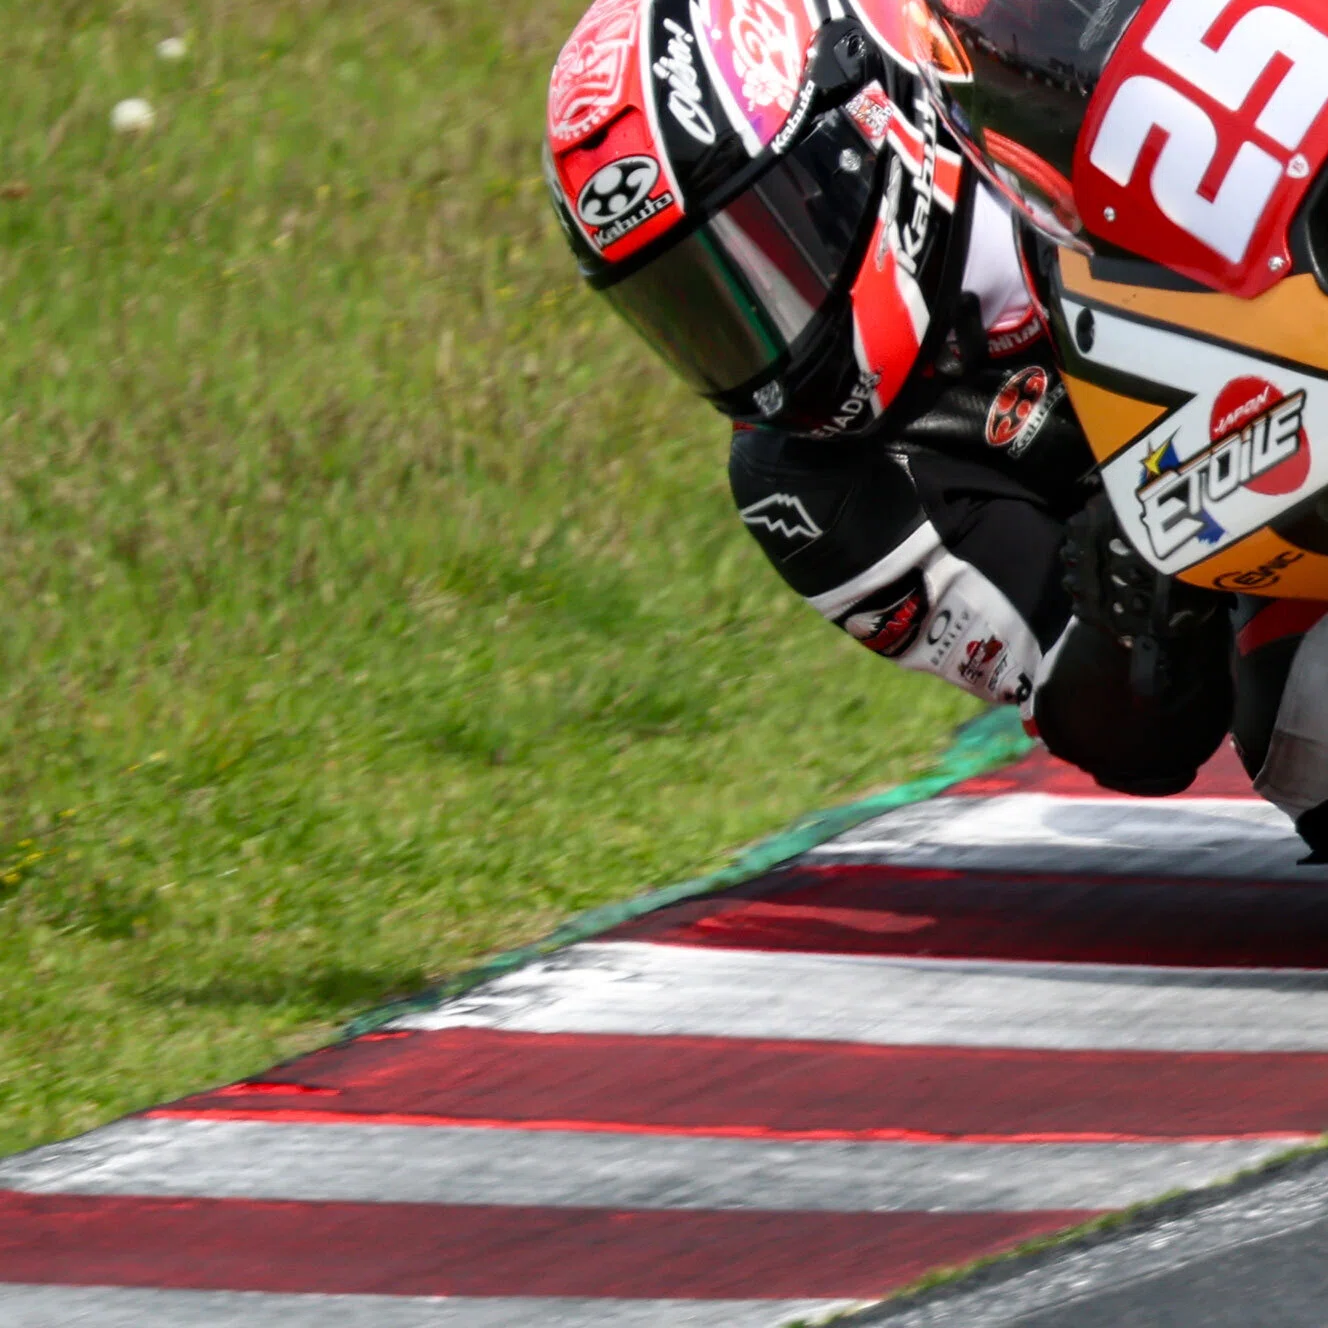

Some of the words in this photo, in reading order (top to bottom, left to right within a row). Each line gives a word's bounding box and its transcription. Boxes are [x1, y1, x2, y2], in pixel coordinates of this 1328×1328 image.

[771, 79, 816, 155] Kabuto
[894, 88, 938, 274] Kabut
[594, 191, 676, 249] Kabuto
